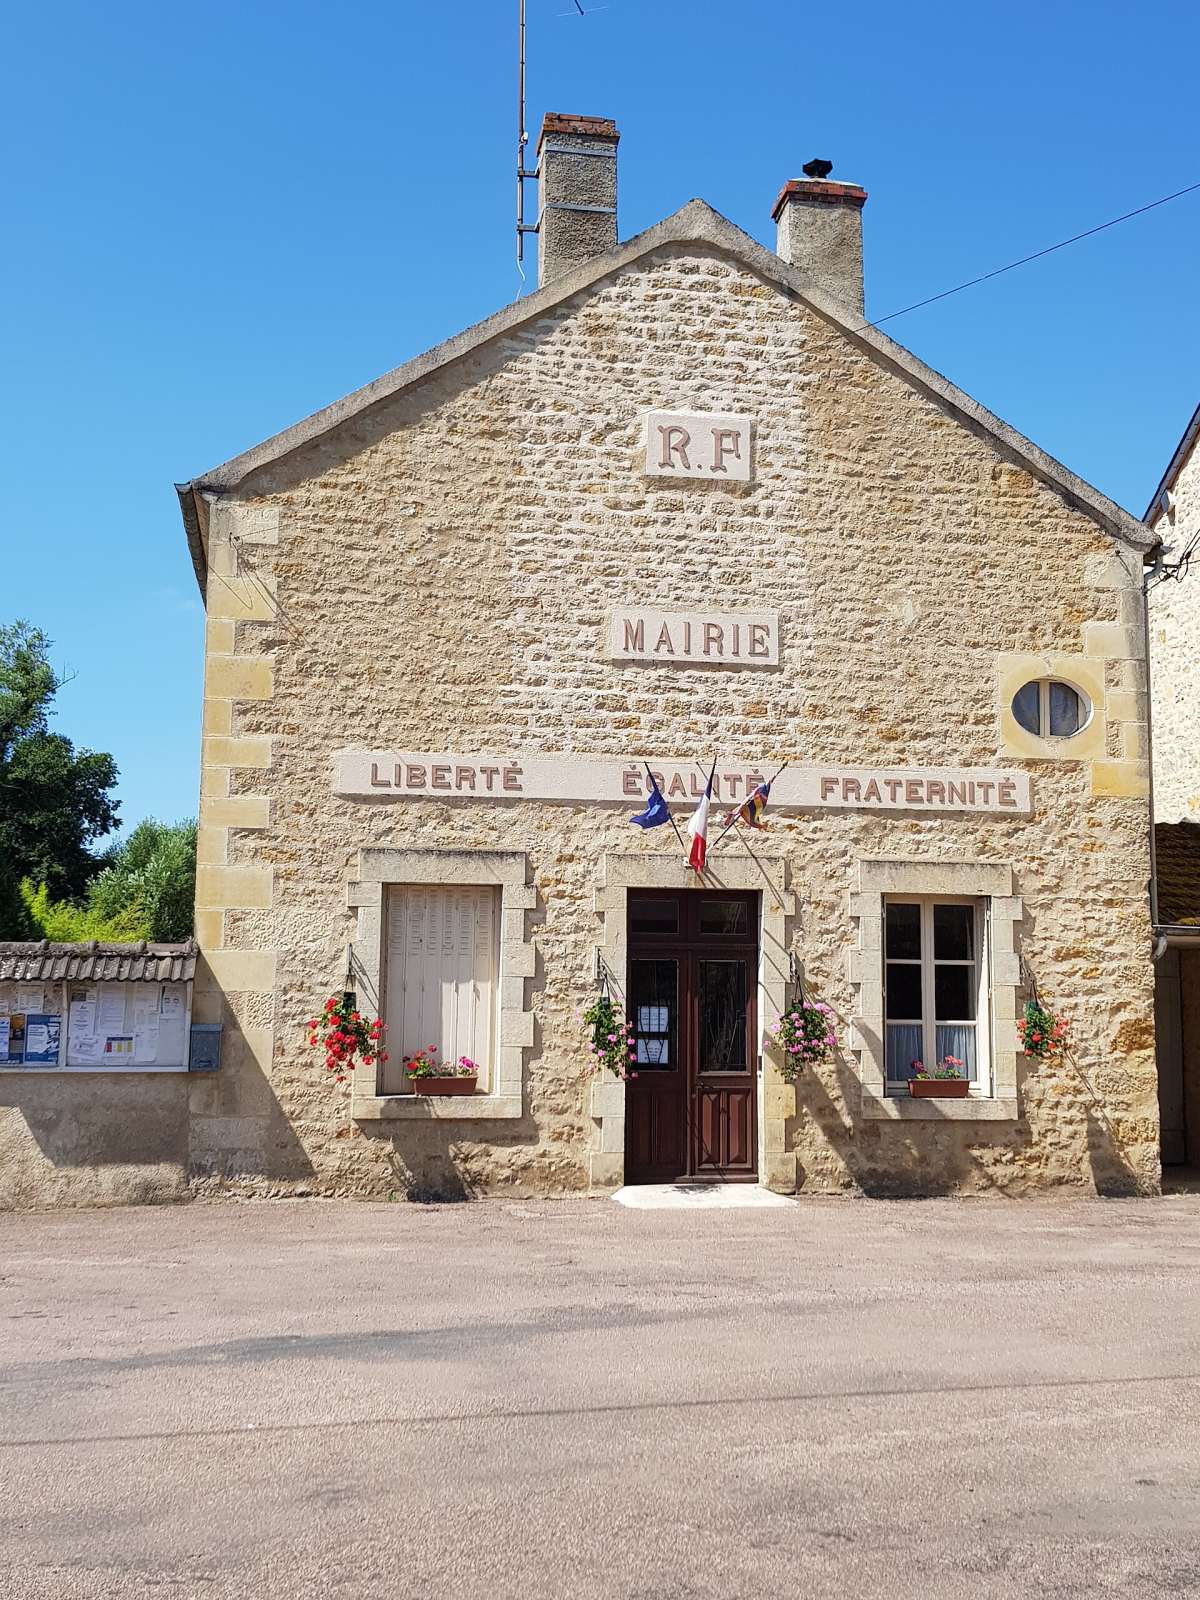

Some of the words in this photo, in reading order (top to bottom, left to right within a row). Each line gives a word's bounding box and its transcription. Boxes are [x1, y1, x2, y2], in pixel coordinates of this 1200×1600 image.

[622, 618, 770, 658] MAIRIE
[371, 760, 523, 791] LIBERTÉ
[820, 776, 1017, 807] FRATERNITÉ
